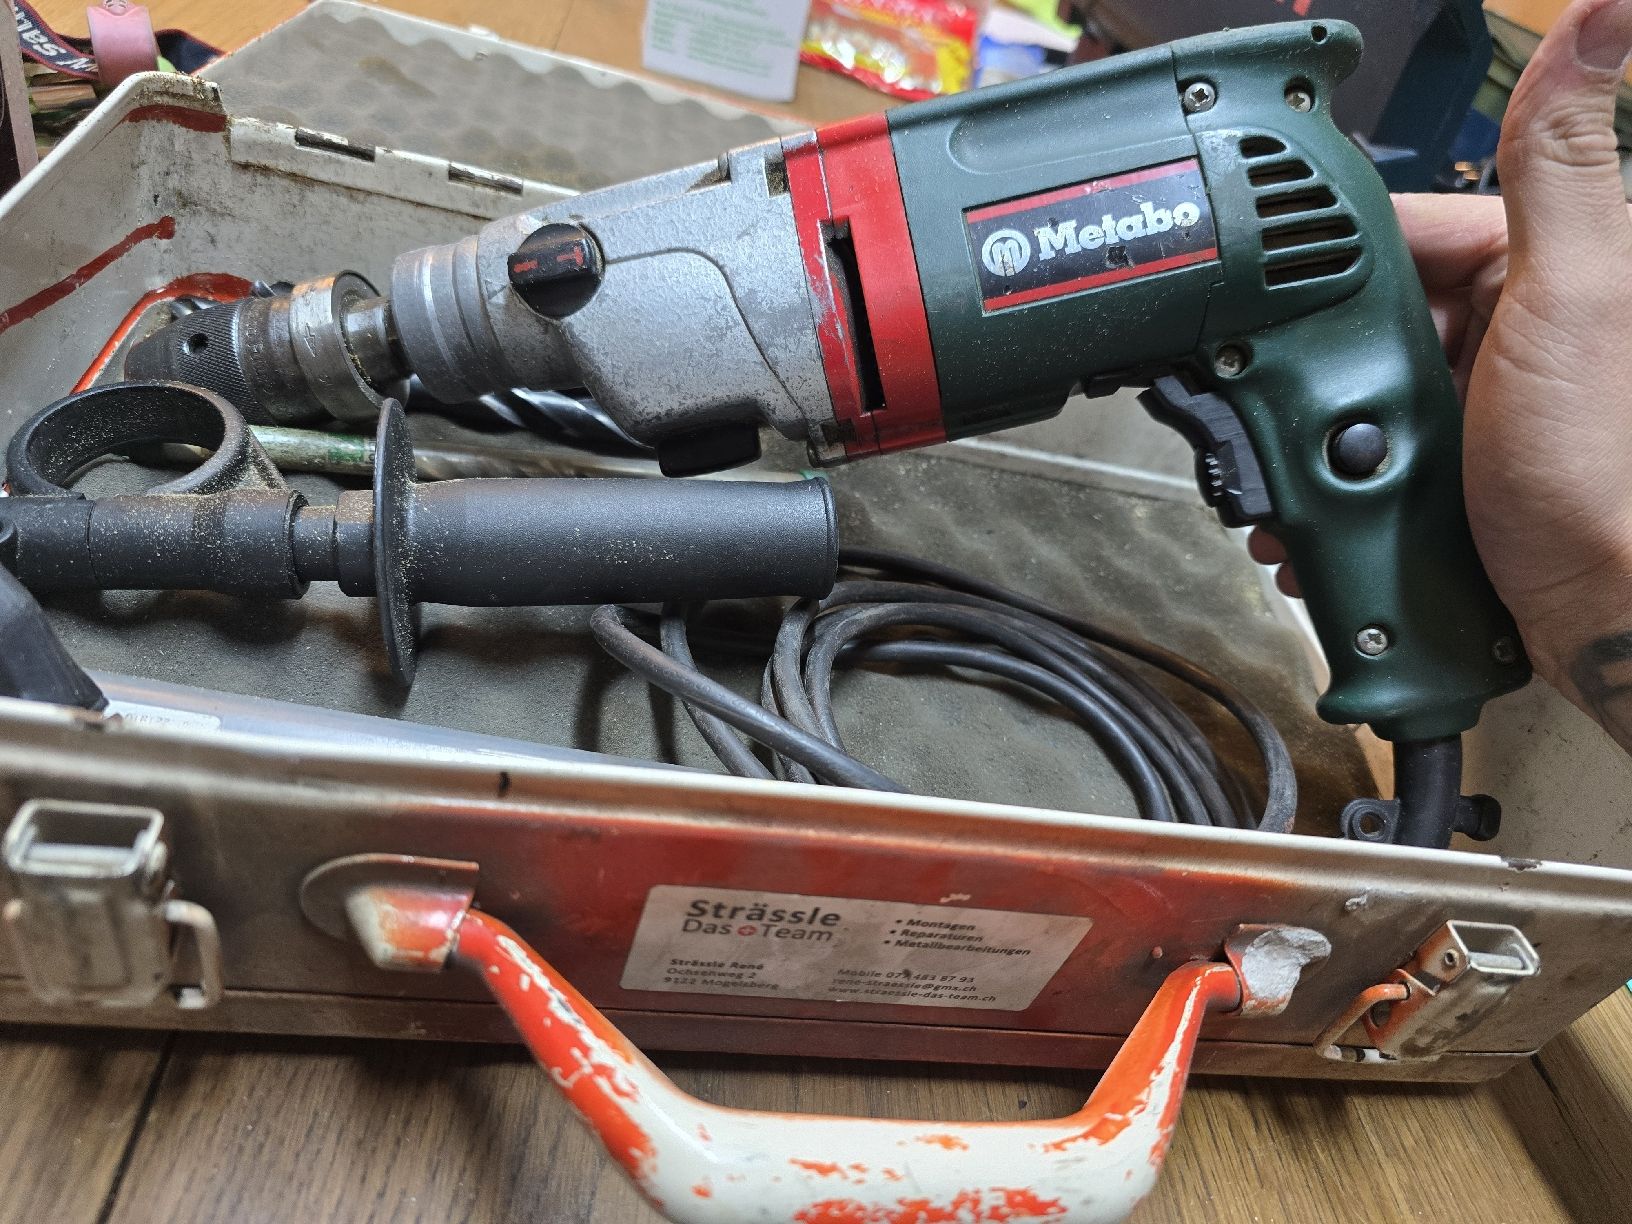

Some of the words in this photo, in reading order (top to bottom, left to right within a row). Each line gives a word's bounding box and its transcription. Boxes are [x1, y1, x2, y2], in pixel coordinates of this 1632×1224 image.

[1034, 201, 1200, 261] Metabo
[686, 899, 841, 927] Strässle
[682, 919, 732, 935] Das
[760, 924, 833, 941] Team
[907, 919, 976, 931] Montagen
[901, 929, 984, 943] Reparaturen
[895, 940, 1031, 956] Metallbearbeitungen
[837, 969, 882, 979] Mobile
[827, 988, 997, 1002] www.straessle-das-team.ch
